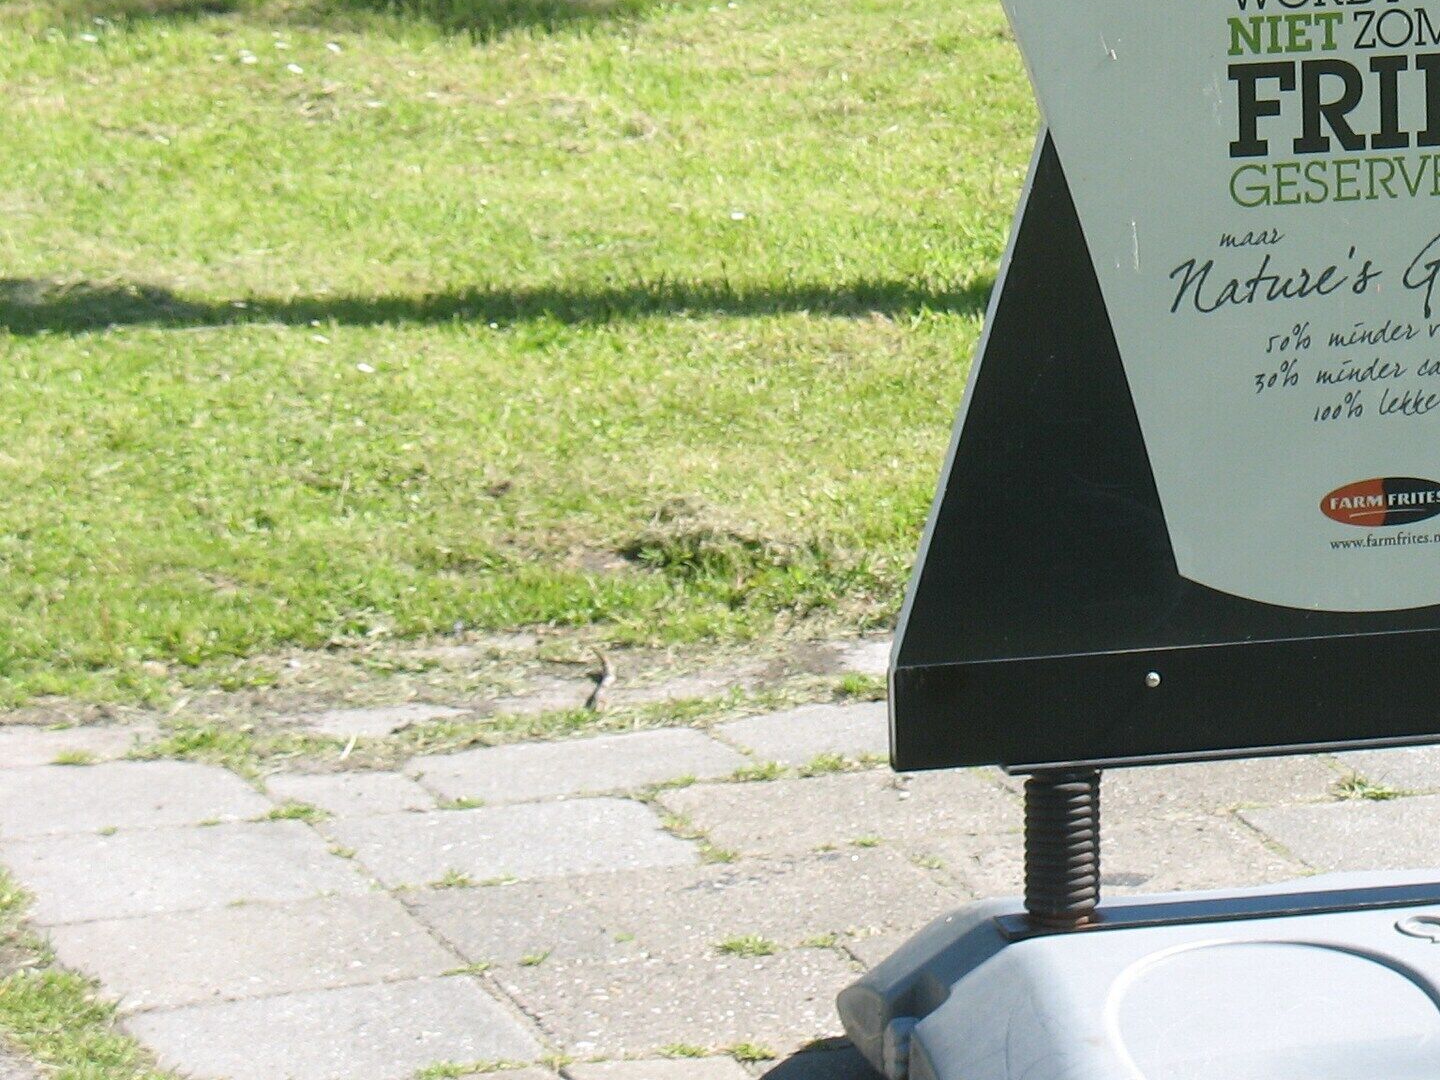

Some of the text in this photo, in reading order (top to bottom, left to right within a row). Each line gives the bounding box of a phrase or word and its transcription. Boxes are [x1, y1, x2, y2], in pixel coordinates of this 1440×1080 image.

[1226, 11, 1344, 56] NIET
[1218, 227, 1285, 249] maar
[1169, 246, 1383, 314] Nature's
[1265, 321, 1312, 354] 50%
[1328, 319, 1420, 348] minder
[1254, 359, 1300, 394] 30%
[1315, 357, 1407, 385] minder
[1312, 389, 1364, 422] 100%
[1329, 494, 1383, 511] FARM
